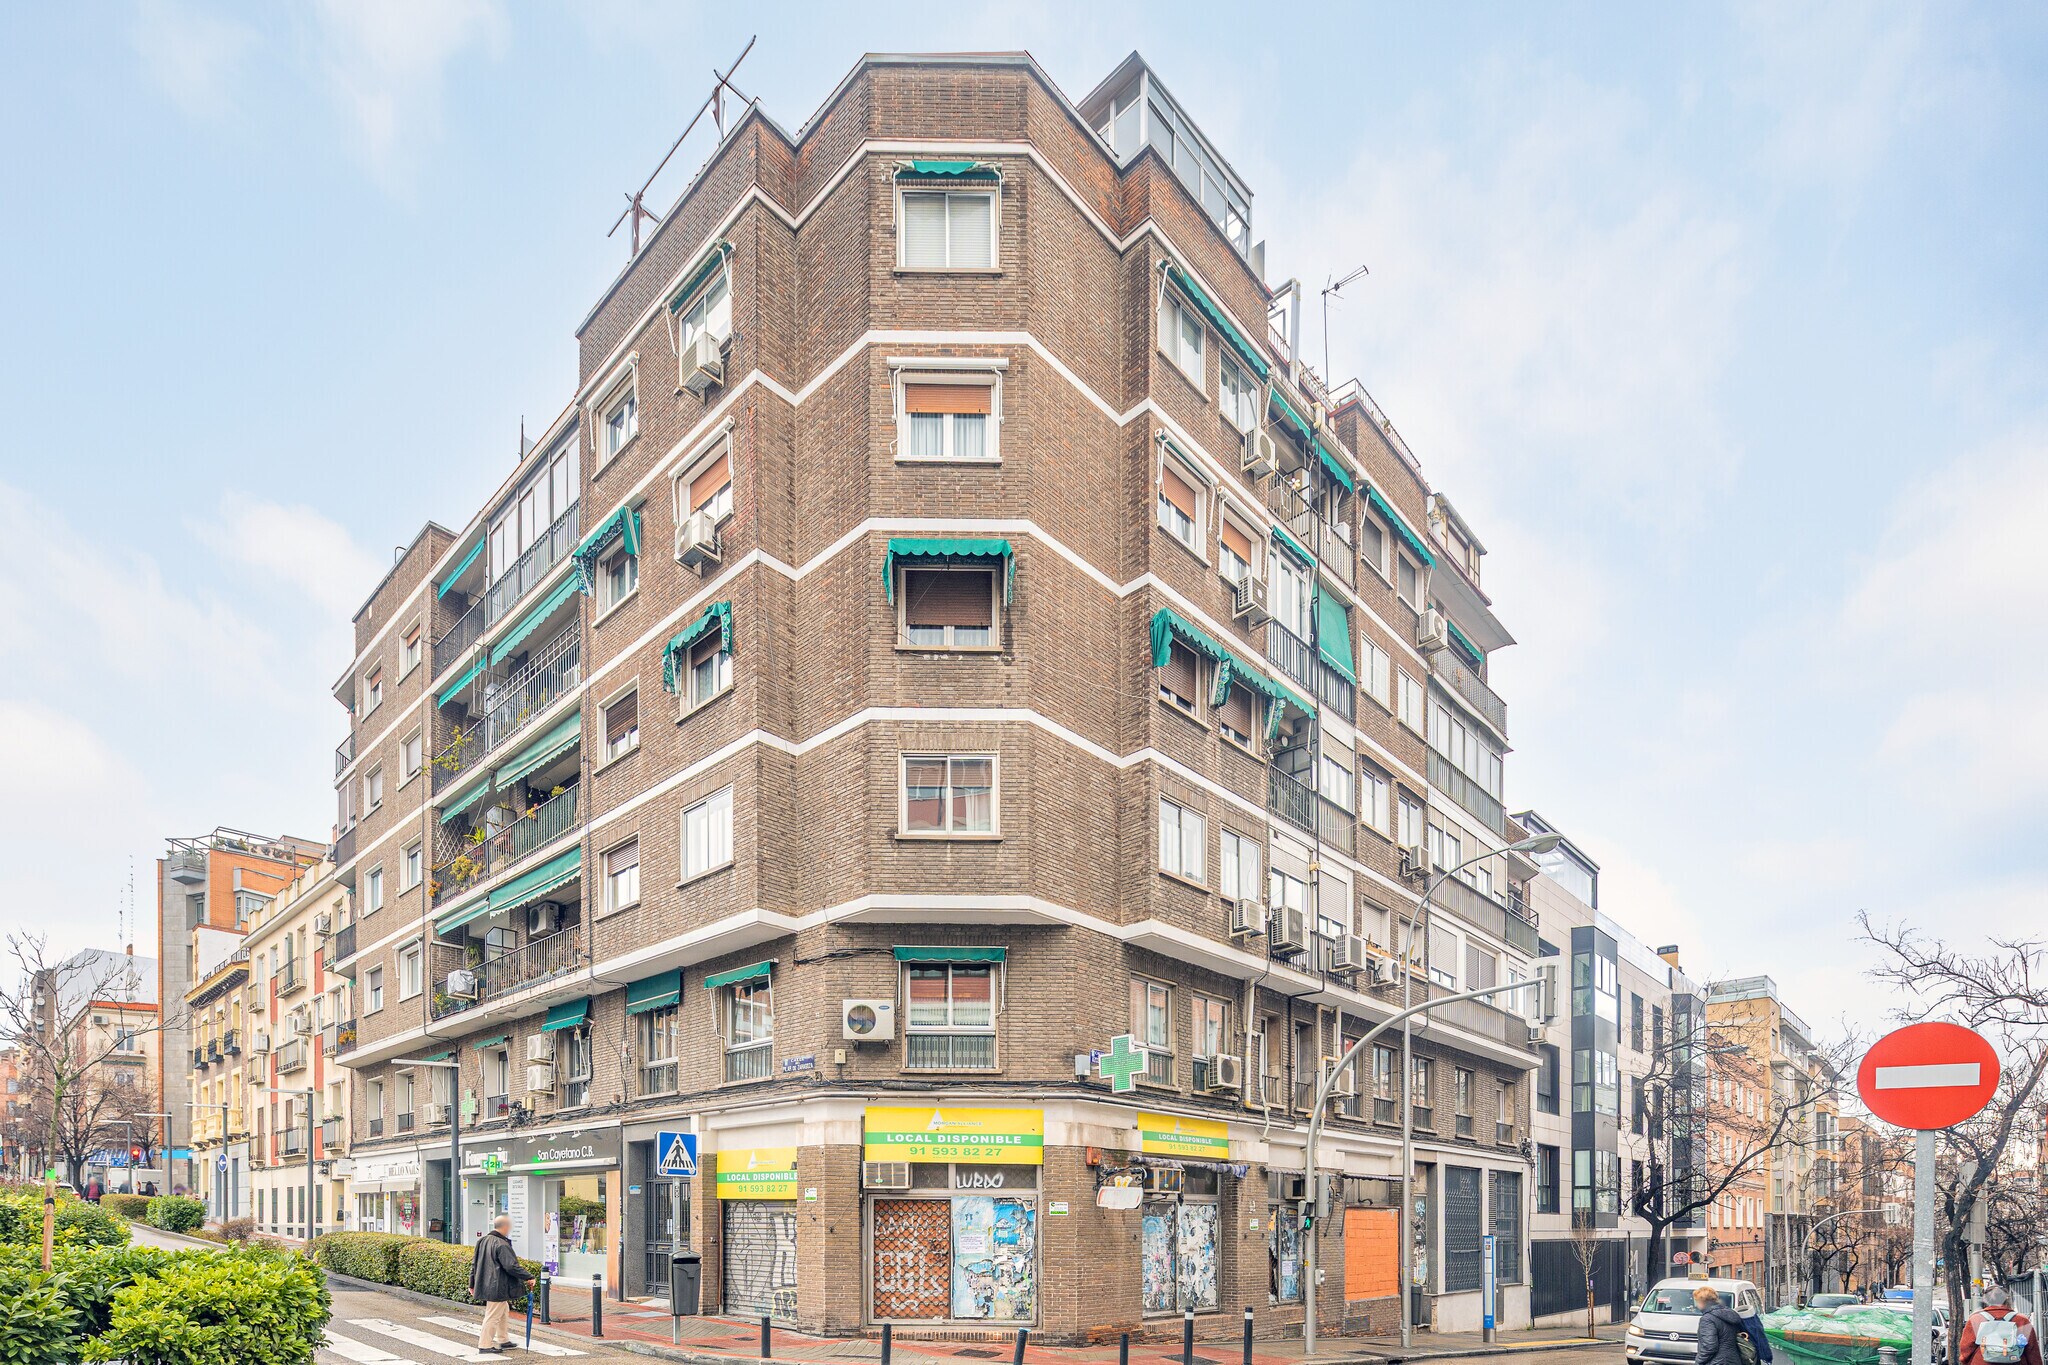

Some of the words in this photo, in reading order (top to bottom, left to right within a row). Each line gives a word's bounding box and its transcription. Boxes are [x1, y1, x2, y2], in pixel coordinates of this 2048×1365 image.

[886, 1134, 932, 1143] LOCAL
[937, 1135, 1022, 1144] DISPONIBLE
[1159, 1134, 1178, 1142] LOCAL
[1179, 1136, 1212, 1144] DISPONIBLE
[537, 1149, 549, 1161] San
[549, 1147, 580, 1161] Cayetano
[581, 1145, 594, 1158] C.B.
[909, 1147, 926, 1155] 91
[932, 1147, 958, 1156] 593
[963, 1147, 980, 1156] 82
[985, 1148, 1002, 1157] 27
[753, 1172, 797, 1181] DISPONIBLE
[738, 1184, 747, 1192] 91
[750, 1184, 764, 1193] 593
[767, 1184, 776, 1192] 82
[778, 1184, 788, 1192] 27
